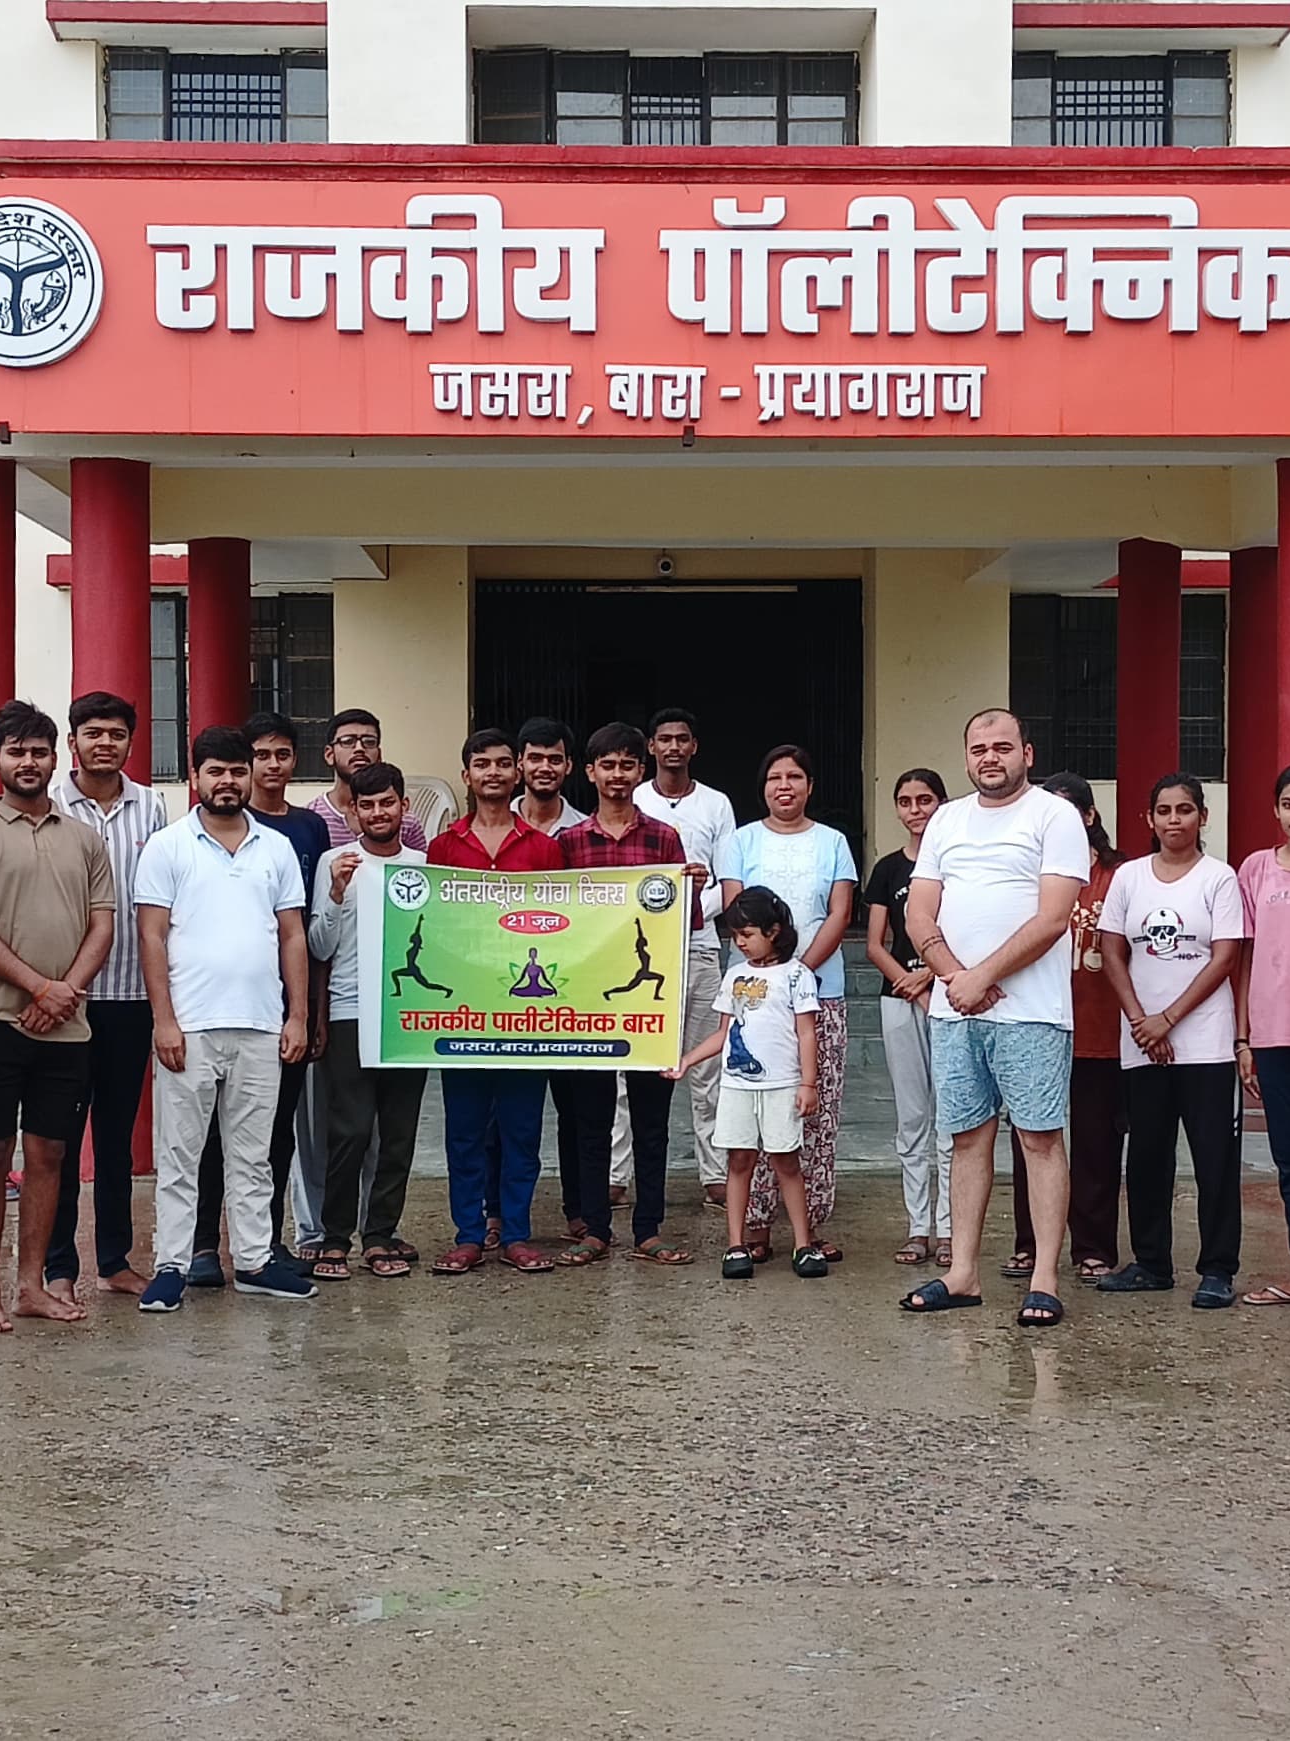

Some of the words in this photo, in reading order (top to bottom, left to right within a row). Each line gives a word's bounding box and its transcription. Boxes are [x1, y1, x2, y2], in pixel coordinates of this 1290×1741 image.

[41, 218, 87, 280] सरकार
[146, 193, 606, 334] राजकीय
[604, 363, 707, 420] बारा
[754, 363, 987, 422] प्रयागराज
[532, 875, 572, 905] योग
[576, 873, 628, 905] दिवस
[507, 915, 525, 927] 21
[531, 915, 562, 931] जून
[399, 1004, 486, 1033] राजकीय
[492, 1005, 617, 1034] पालीटेक्निक
[621, 1012, 666, 1035] बारा
